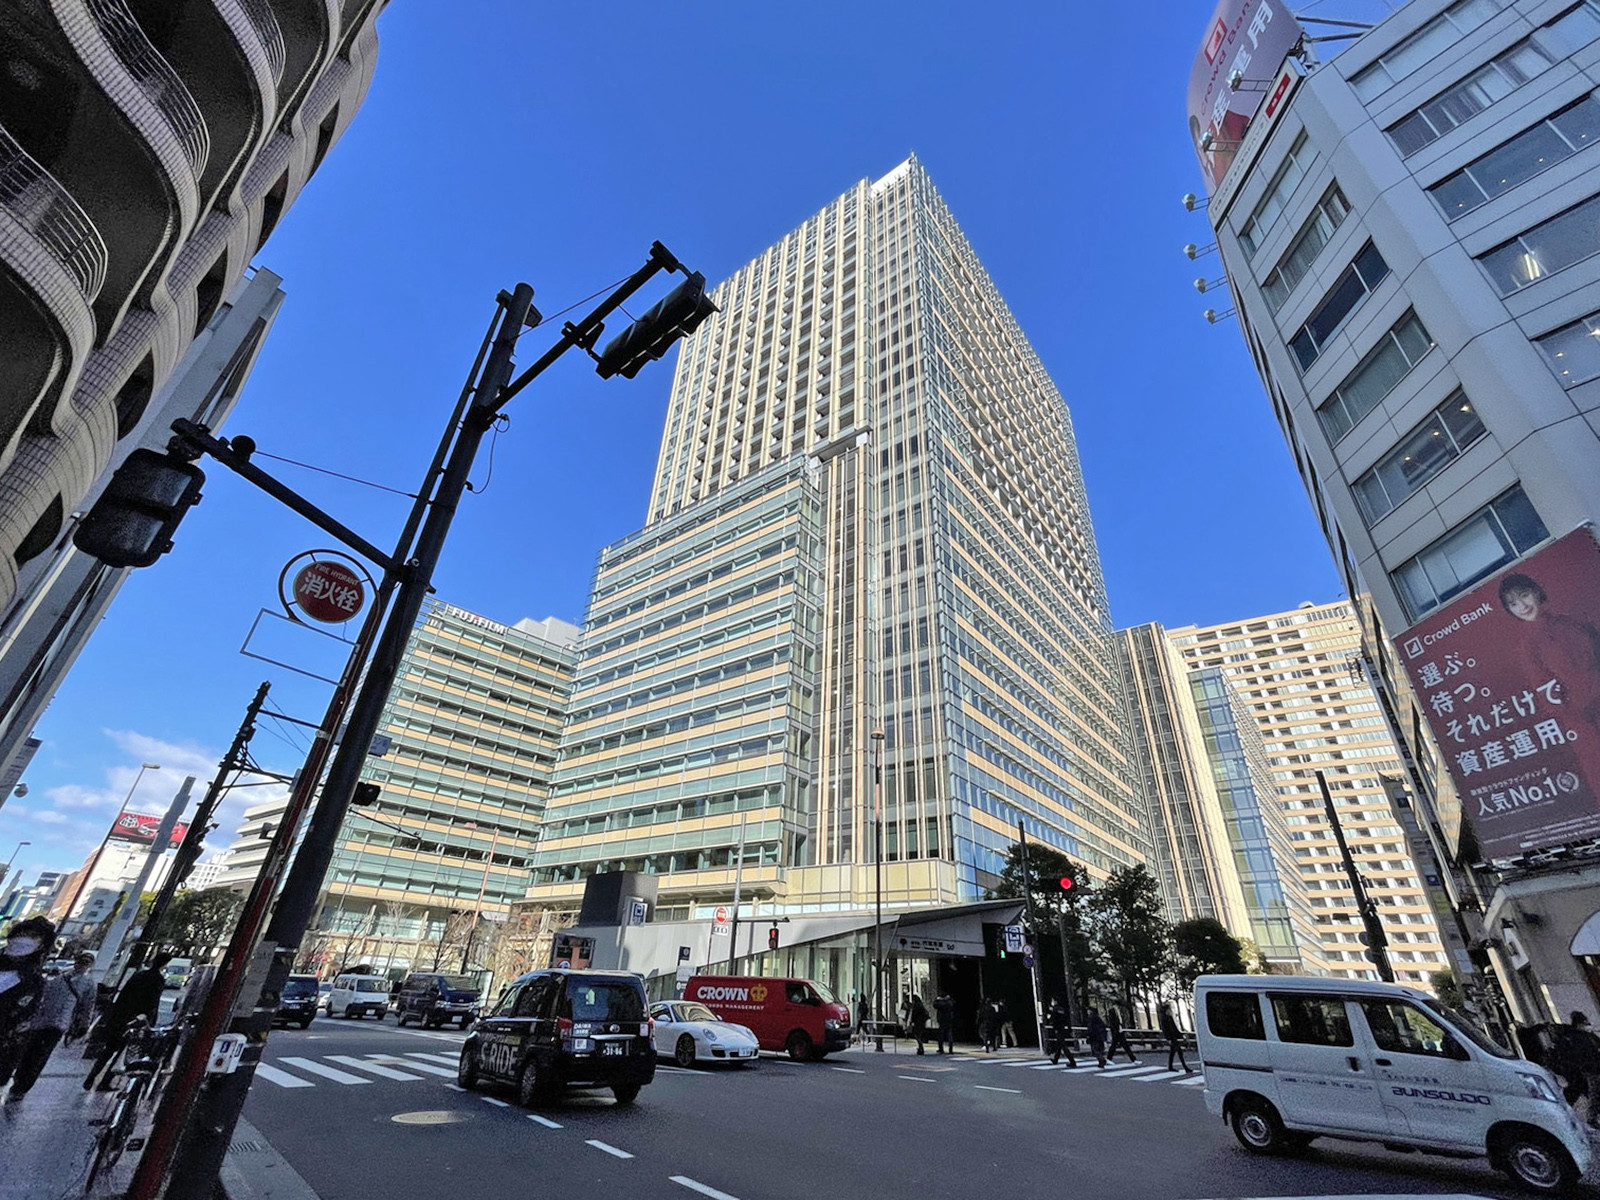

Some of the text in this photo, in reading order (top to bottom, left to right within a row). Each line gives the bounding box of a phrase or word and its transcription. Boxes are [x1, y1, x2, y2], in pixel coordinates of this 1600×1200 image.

[1201, 0, 1253, 116] Crowd Ban
[300, 571, 359, 613] 消火栓
[315, 563, 360, 586] FIRE HYDRANT
[451, 606, 507, 636] FUJIFILM
[1423, 602, 1493, 646] Crowd Bank
[1417, 651, 1476, 689] 選ぶ。
[1430, 682, 1491, 717] 待つ。
[1446, 678, 1562, 743] それだけで
[1455, 718, 1578, 777] 資産運用。
[1479, 776, 1558, 816] 人気No.1
[697, 986, 749, 1001] CROWN
[1391, 1086, 1492, 1106] BUNSOUDO
